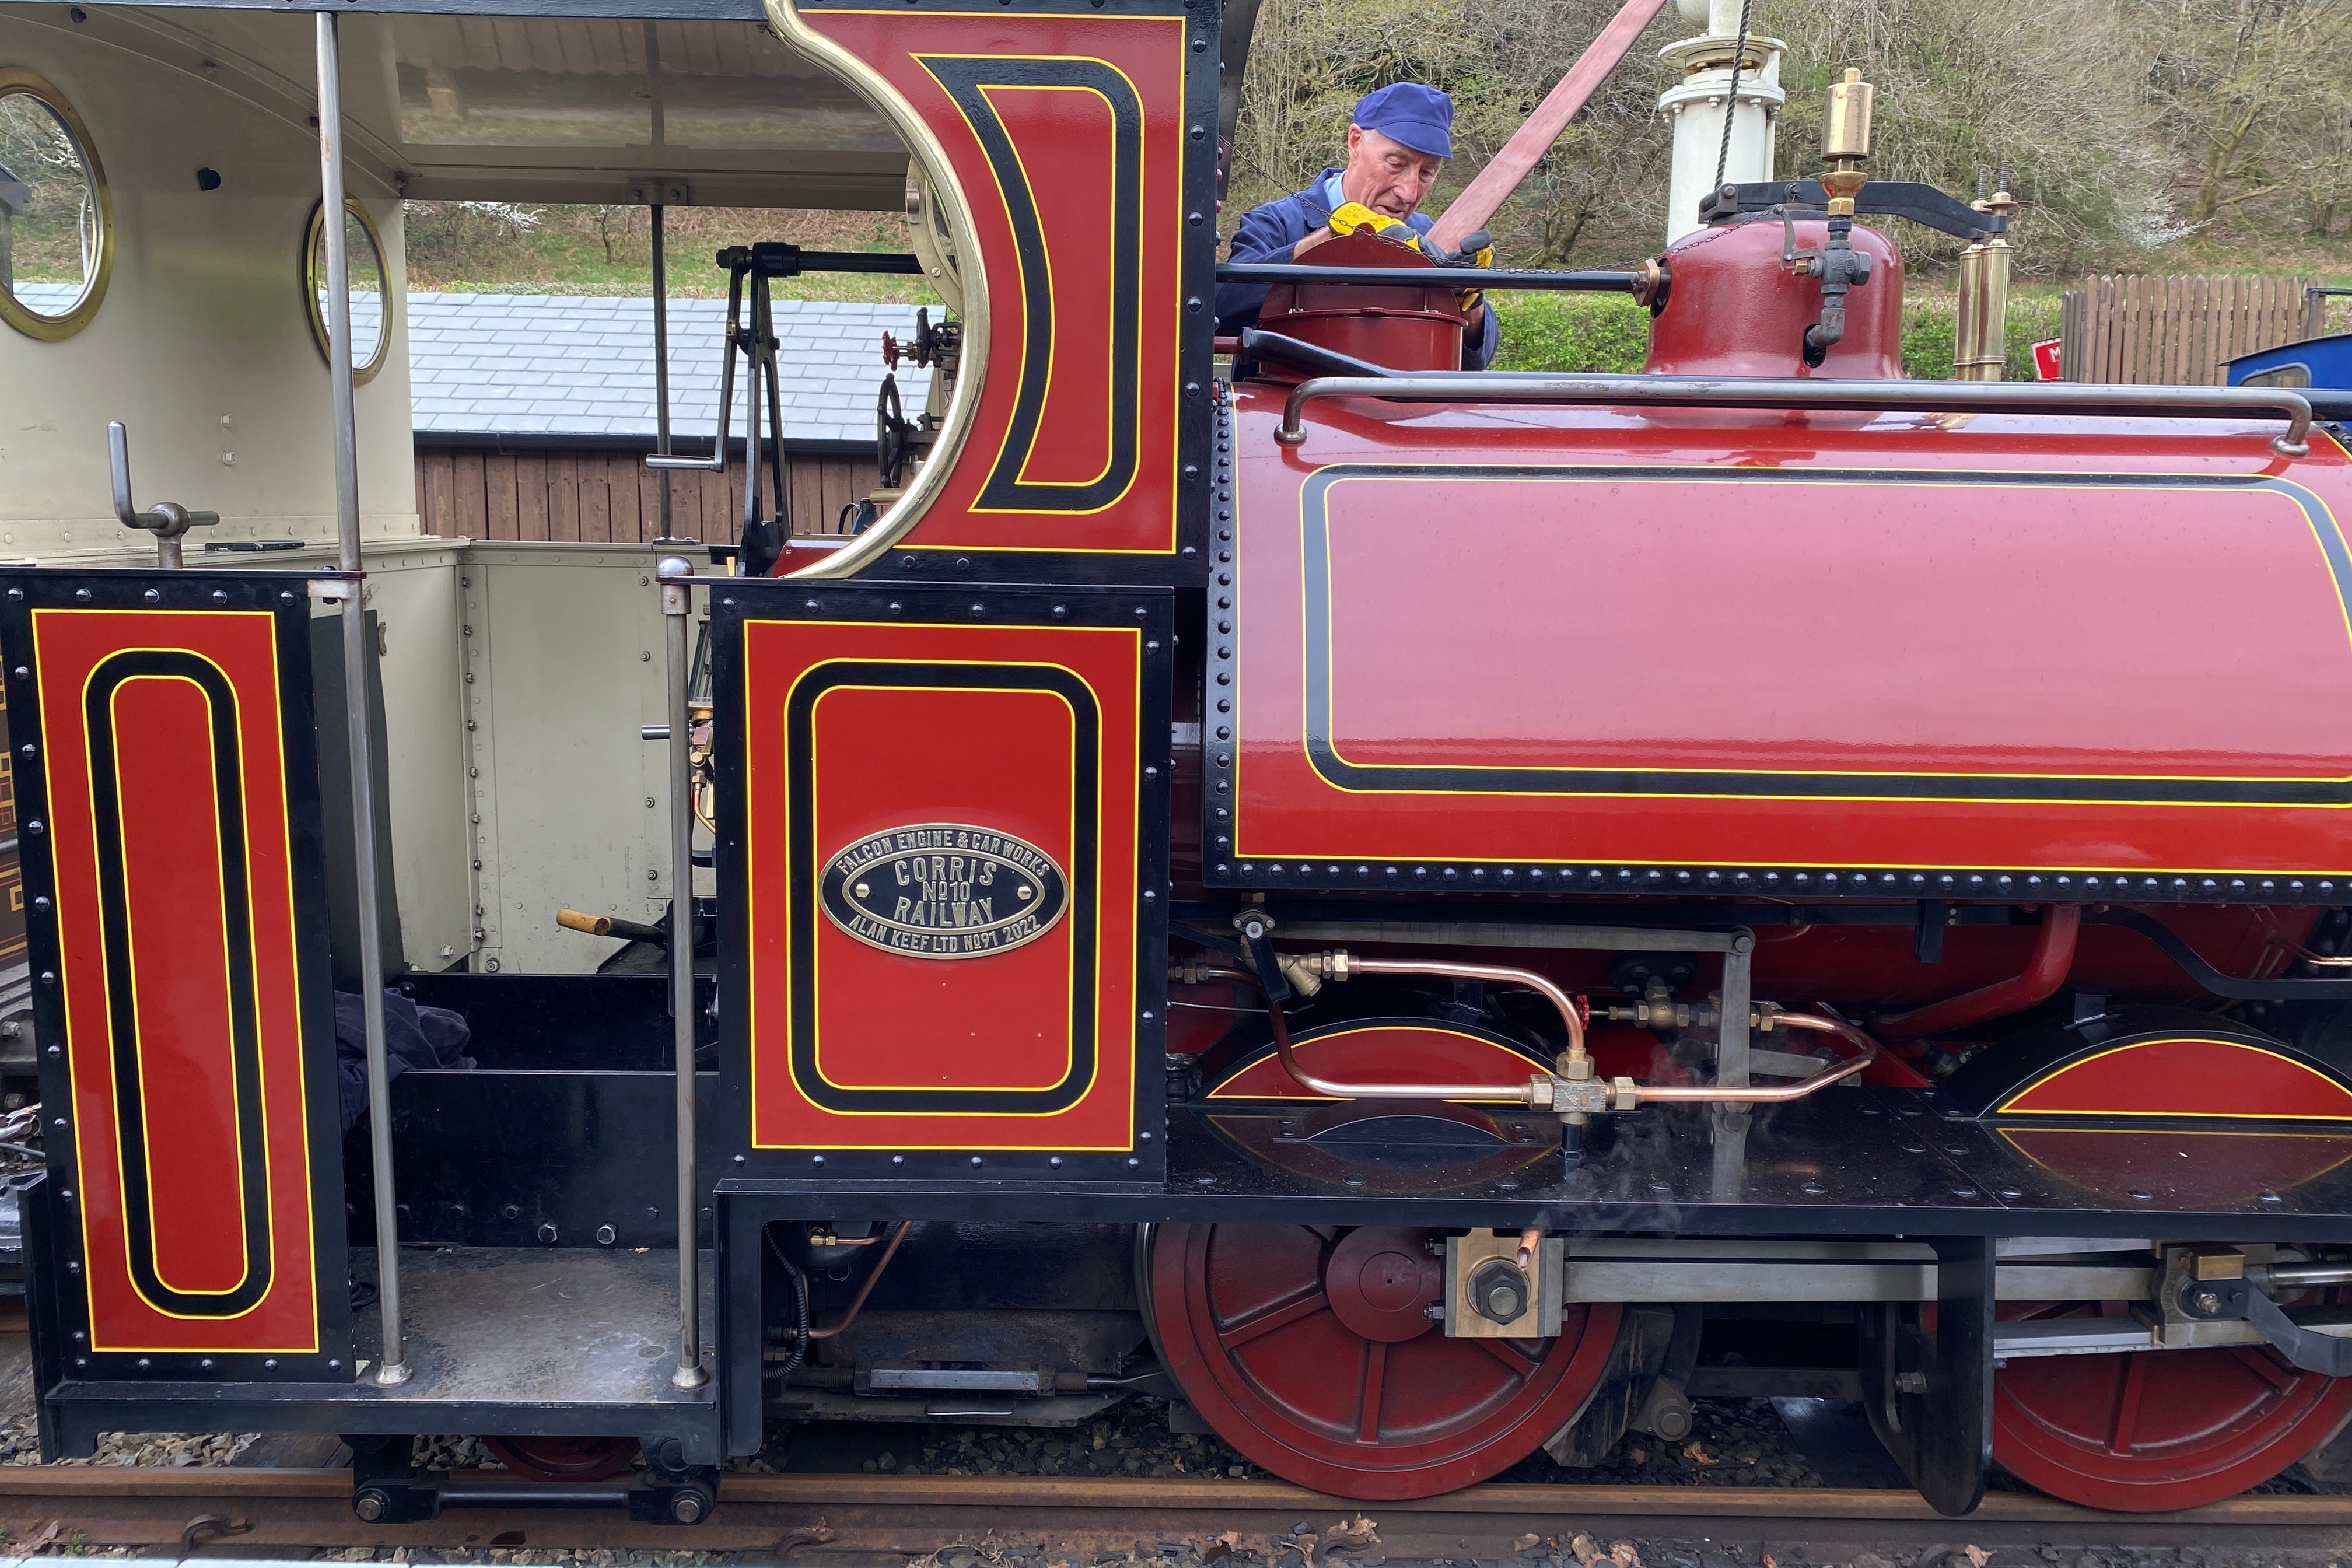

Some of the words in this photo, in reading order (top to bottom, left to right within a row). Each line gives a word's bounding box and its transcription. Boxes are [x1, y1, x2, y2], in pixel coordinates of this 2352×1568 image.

[836, 837, 893, 875] FALCON
[897, 831, 953, 850] ENGINE
[957, 832, 968, 848] &
[972, 834, 1000, 853] CAR
[1002, 841, 1050, 877] WORKS
[895, 856, 997, 886] CORRIS
[894, 896, 993, 927] RAILWAY
[849, 915, 887, 942] ALAN
[891, 930, 930, 950] KEEF
[933, 936, 958, 952] LTD
[1003, 915, 1041, 943] 2022
